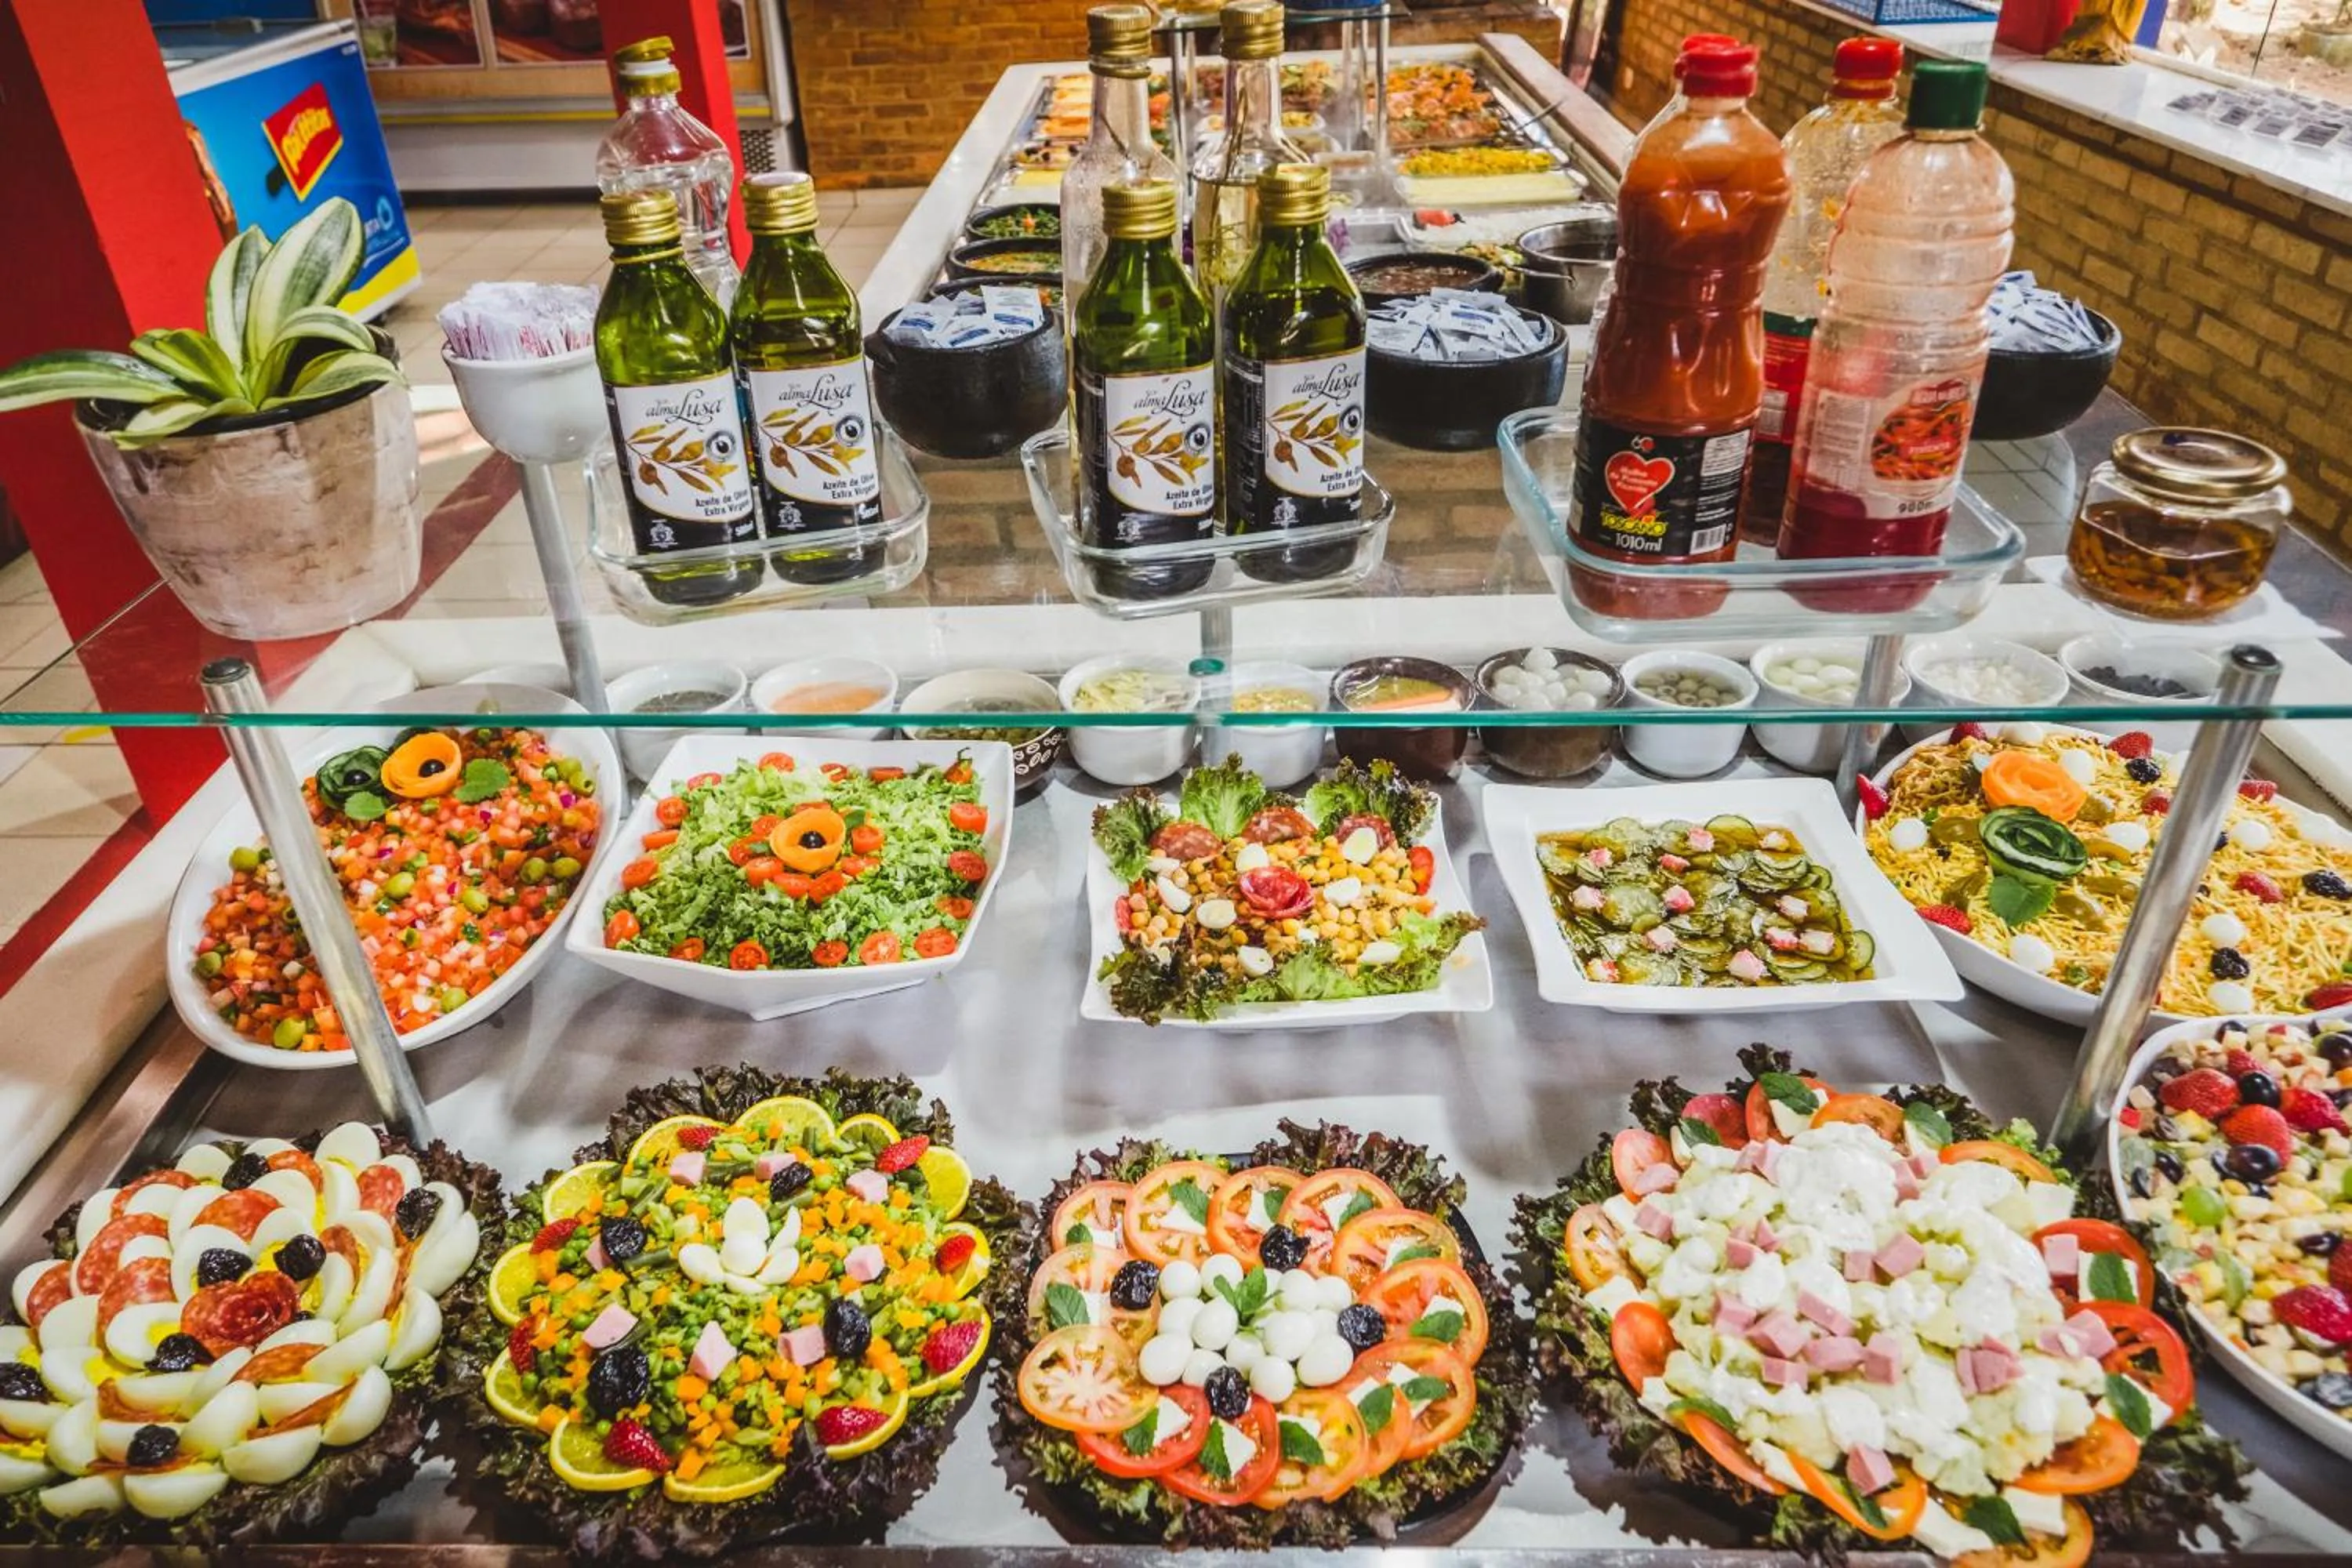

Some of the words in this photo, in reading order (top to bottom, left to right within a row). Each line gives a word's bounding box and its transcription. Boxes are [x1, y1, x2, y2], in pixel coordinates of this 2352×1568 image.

[1320, 474, 1342, 483] Azeite
[1345, 470, 1352, 478] de
[823, 481, 848, 490] Azeite
[849, 477, 858, 486] de
[1327, 483, 1346, 492] Extra
[831, 491, 852, 499] Extra
[1166, 490, 1189, 499] Azeite
[695, 497, 720, 506] Azeite
[1173, 500, 1192, 510] Extra
[704, 507, 726, 516] Extra
[1615, 532, 1663, 552] 1010ml
